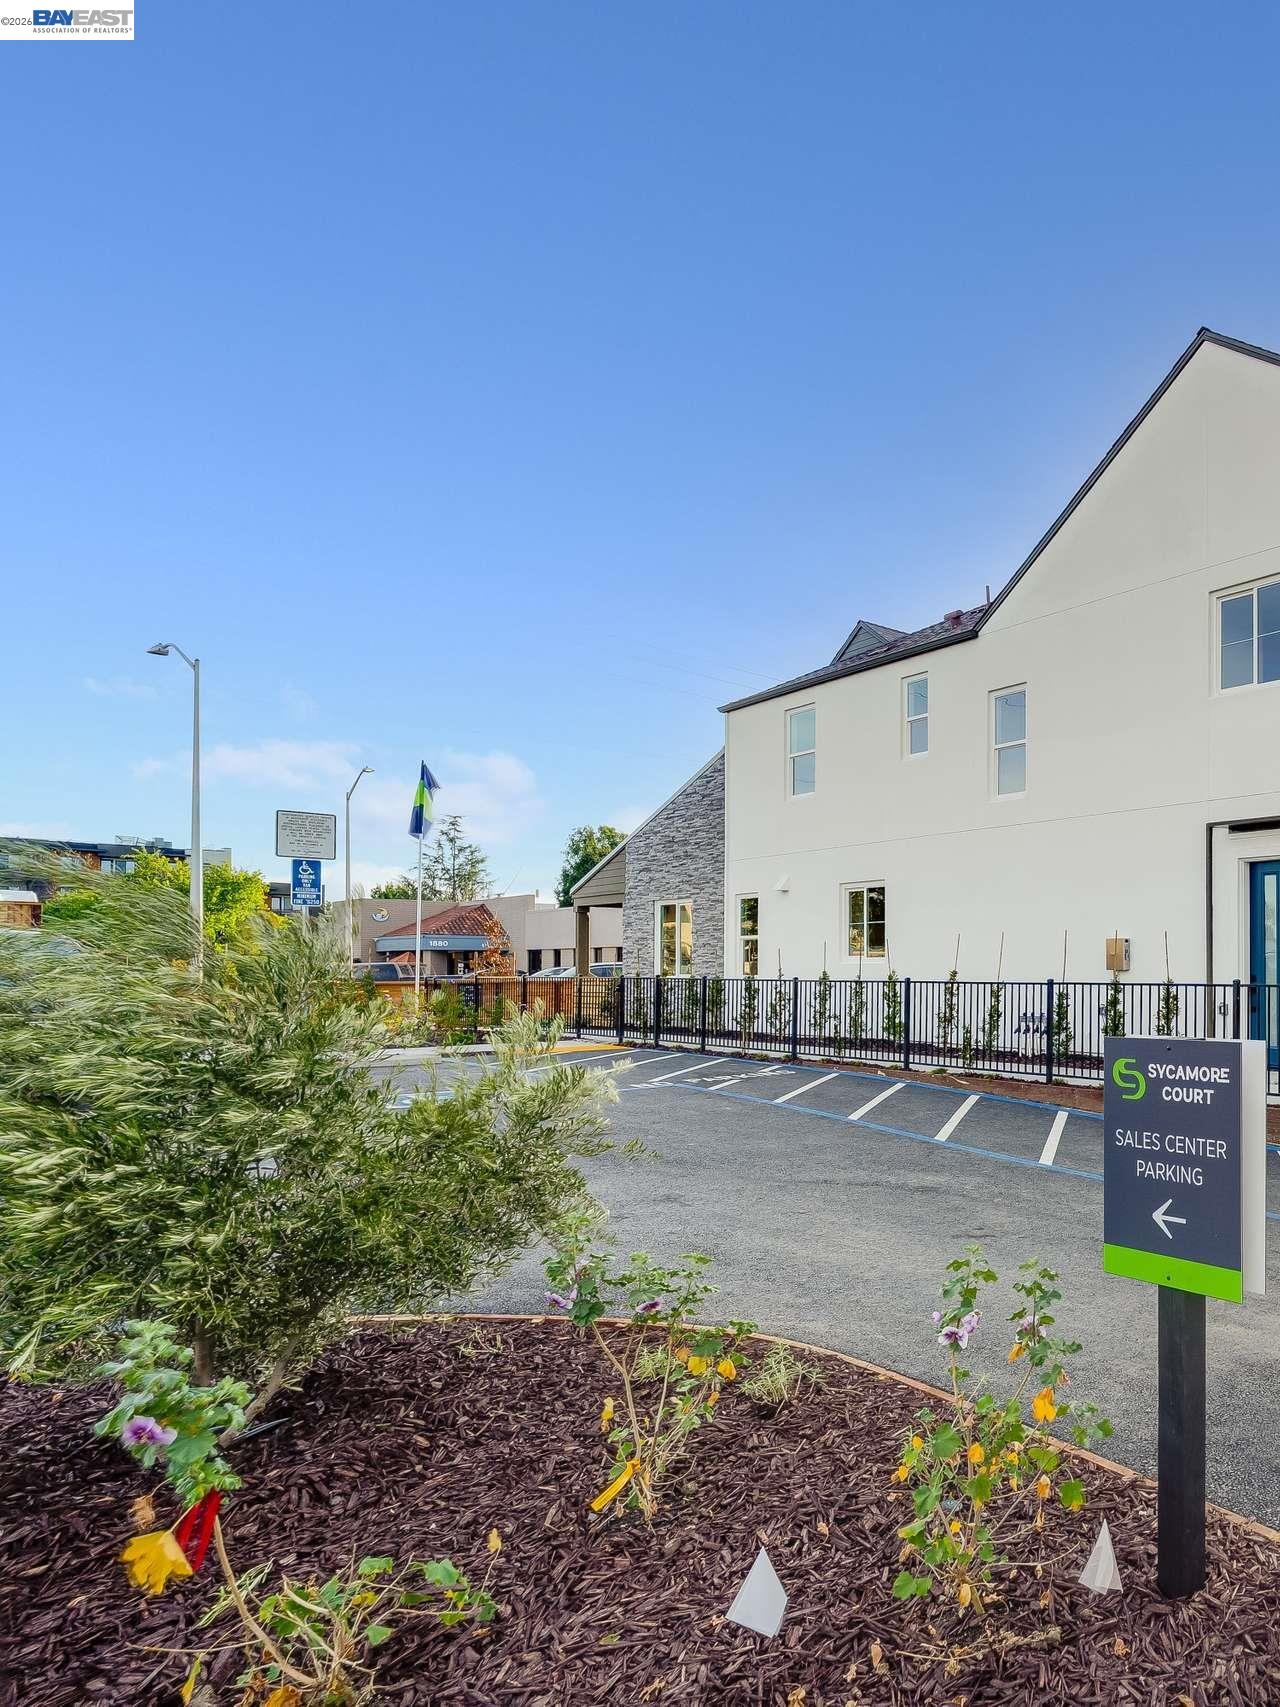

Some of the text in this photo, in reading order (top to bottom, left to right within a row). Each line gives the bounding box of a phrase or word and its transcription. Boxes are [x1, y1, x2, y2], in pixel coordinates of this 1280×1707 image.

[1147, 1063, 1231, 1084] SYCAMORE
[1161, 1086, 1215, 1105] COURT
[1115, 1128, 1228, 1160] SALES CENTER
[1136, 1159, 1204, 1186] PARKING
